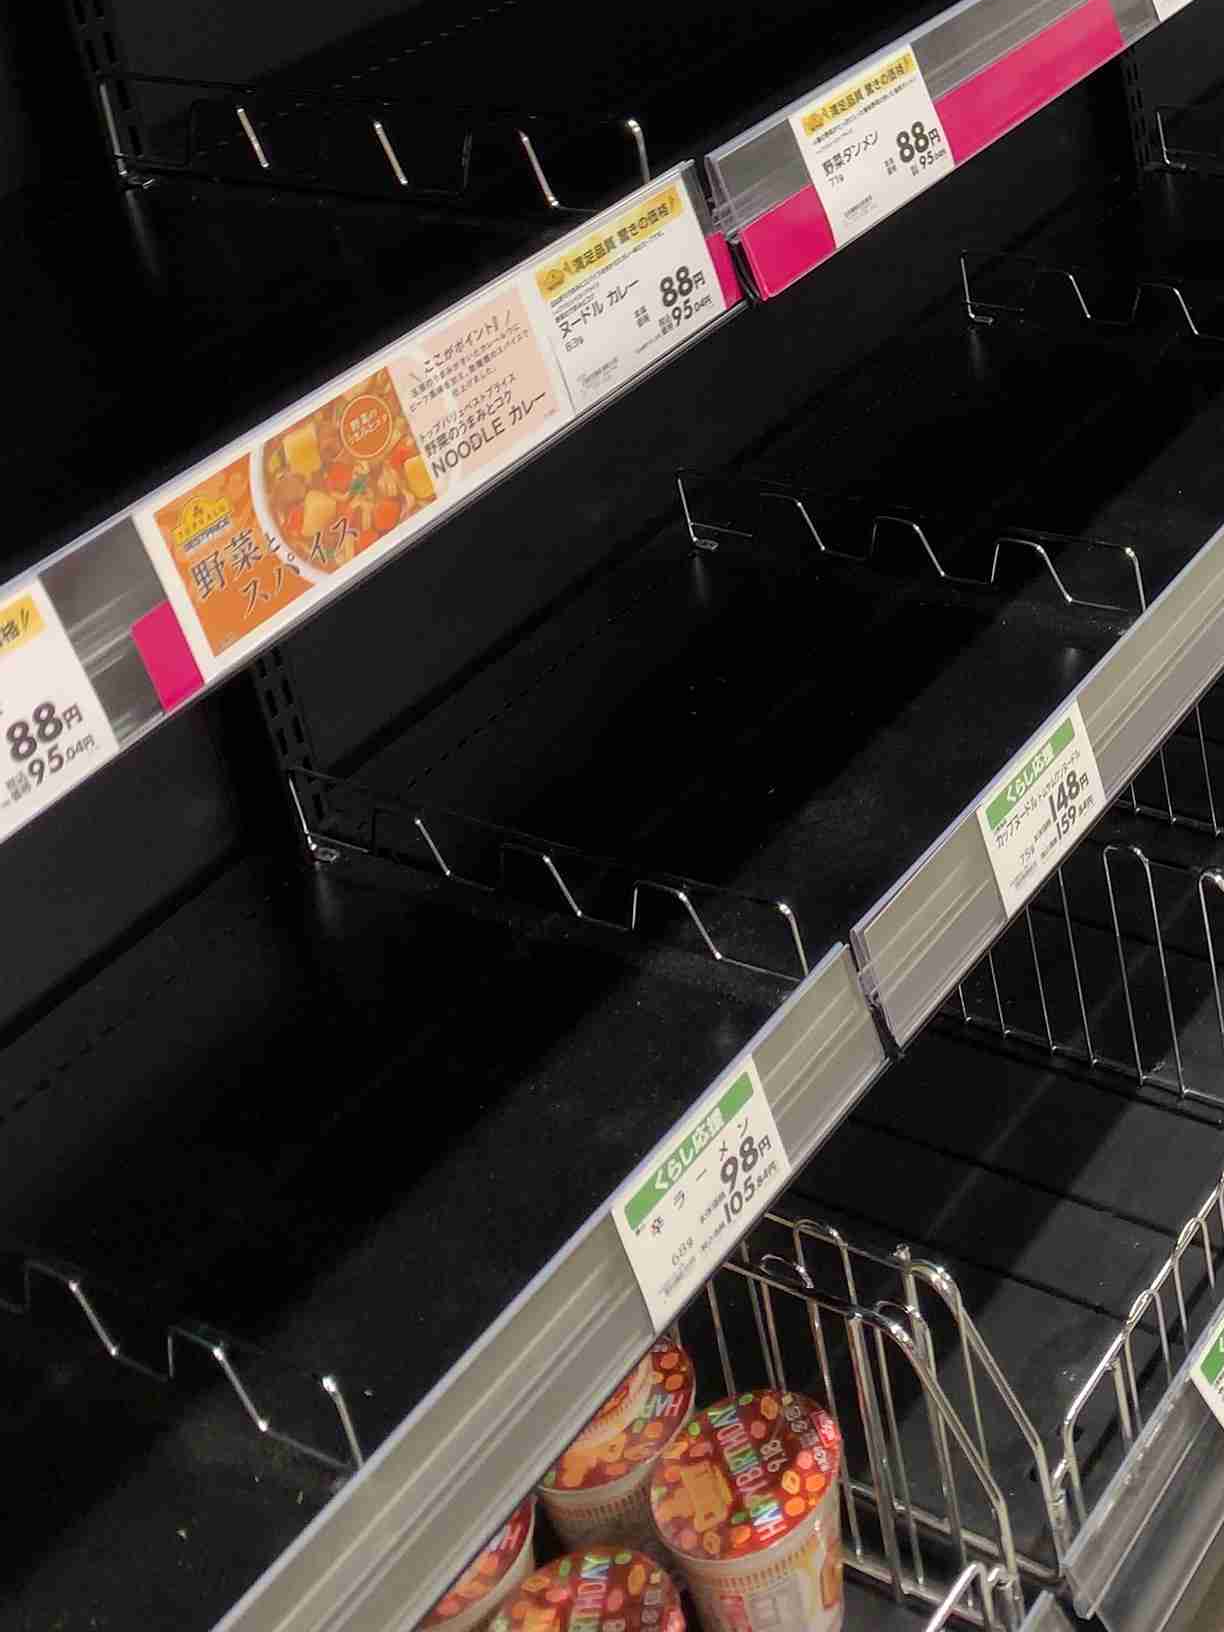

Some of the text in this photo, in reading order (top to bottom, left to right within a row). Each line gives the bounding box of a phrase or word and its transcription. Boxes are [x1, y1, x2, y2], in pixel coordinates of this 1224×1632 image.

[431, 418, 506, 479] NOODLE
[507, 391, 548, 429] カレー
[242, 517, 359, 620] スパイス
